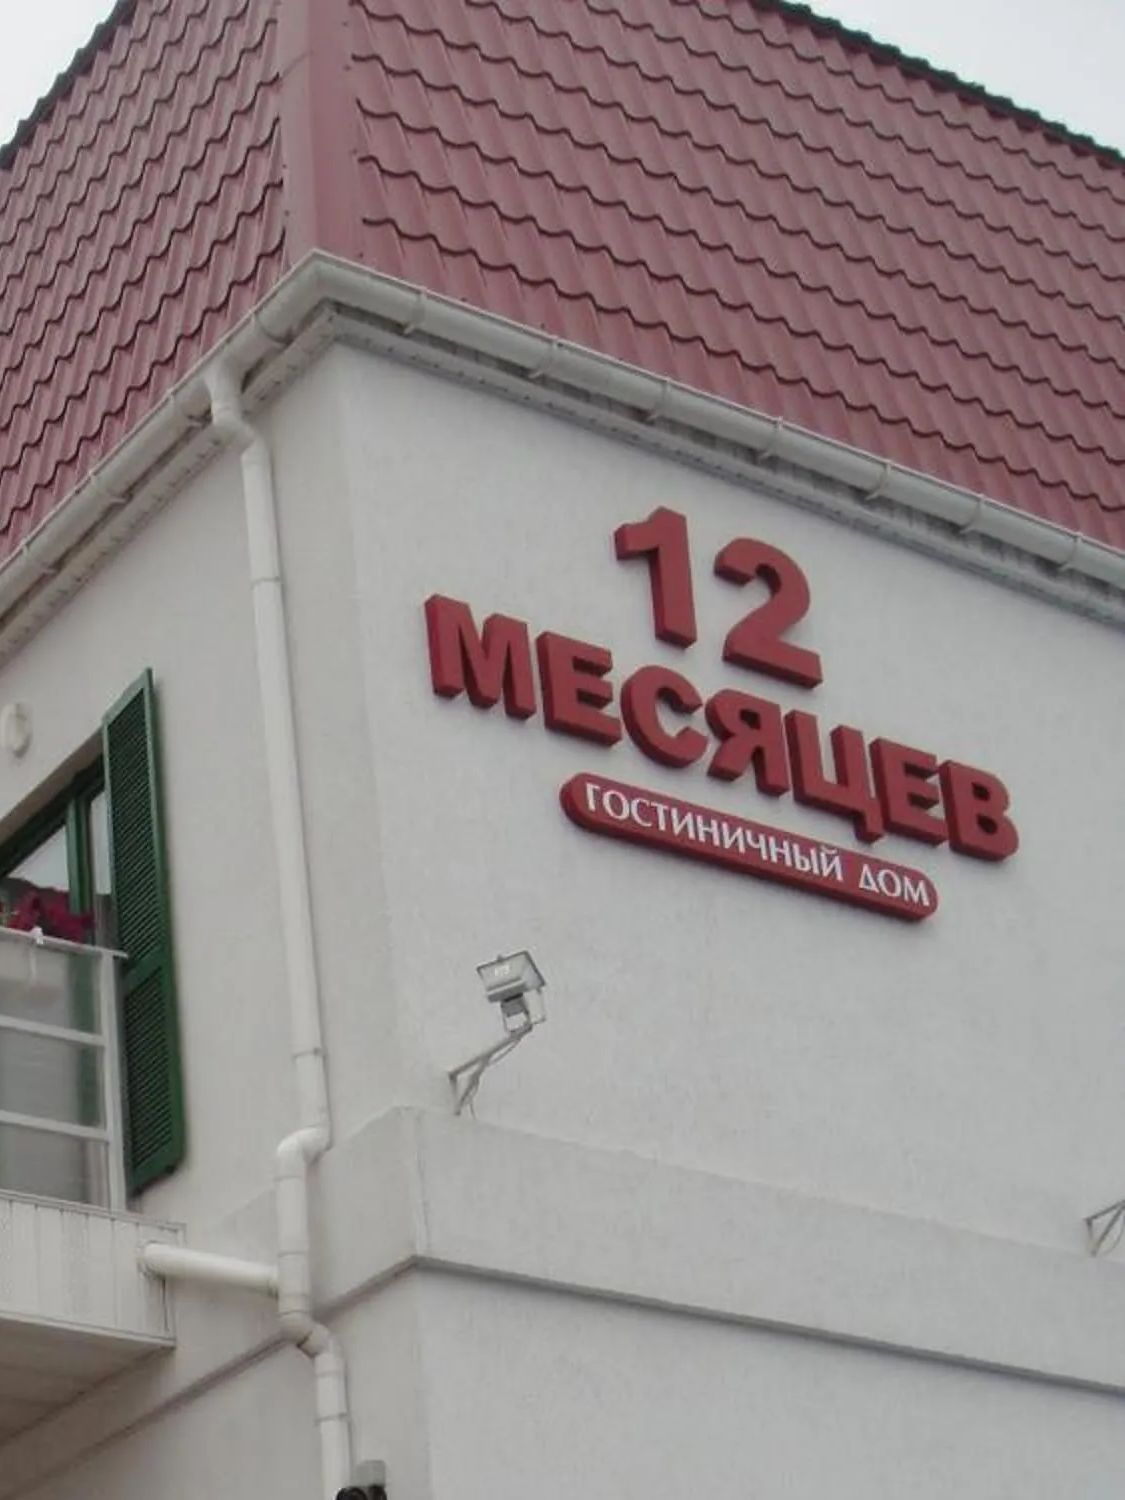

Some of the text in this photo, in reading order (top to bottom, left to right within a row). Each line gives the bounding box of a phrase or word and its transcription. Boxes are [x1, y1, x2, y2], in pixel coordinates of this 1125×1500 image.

[614, 506, 823, 689] 12
[424, 593, 1020, 862] МЕСЯЦЕВ
[585, 782, 930, 907] ГОСТИНИЧНЫЙ ДОМ
